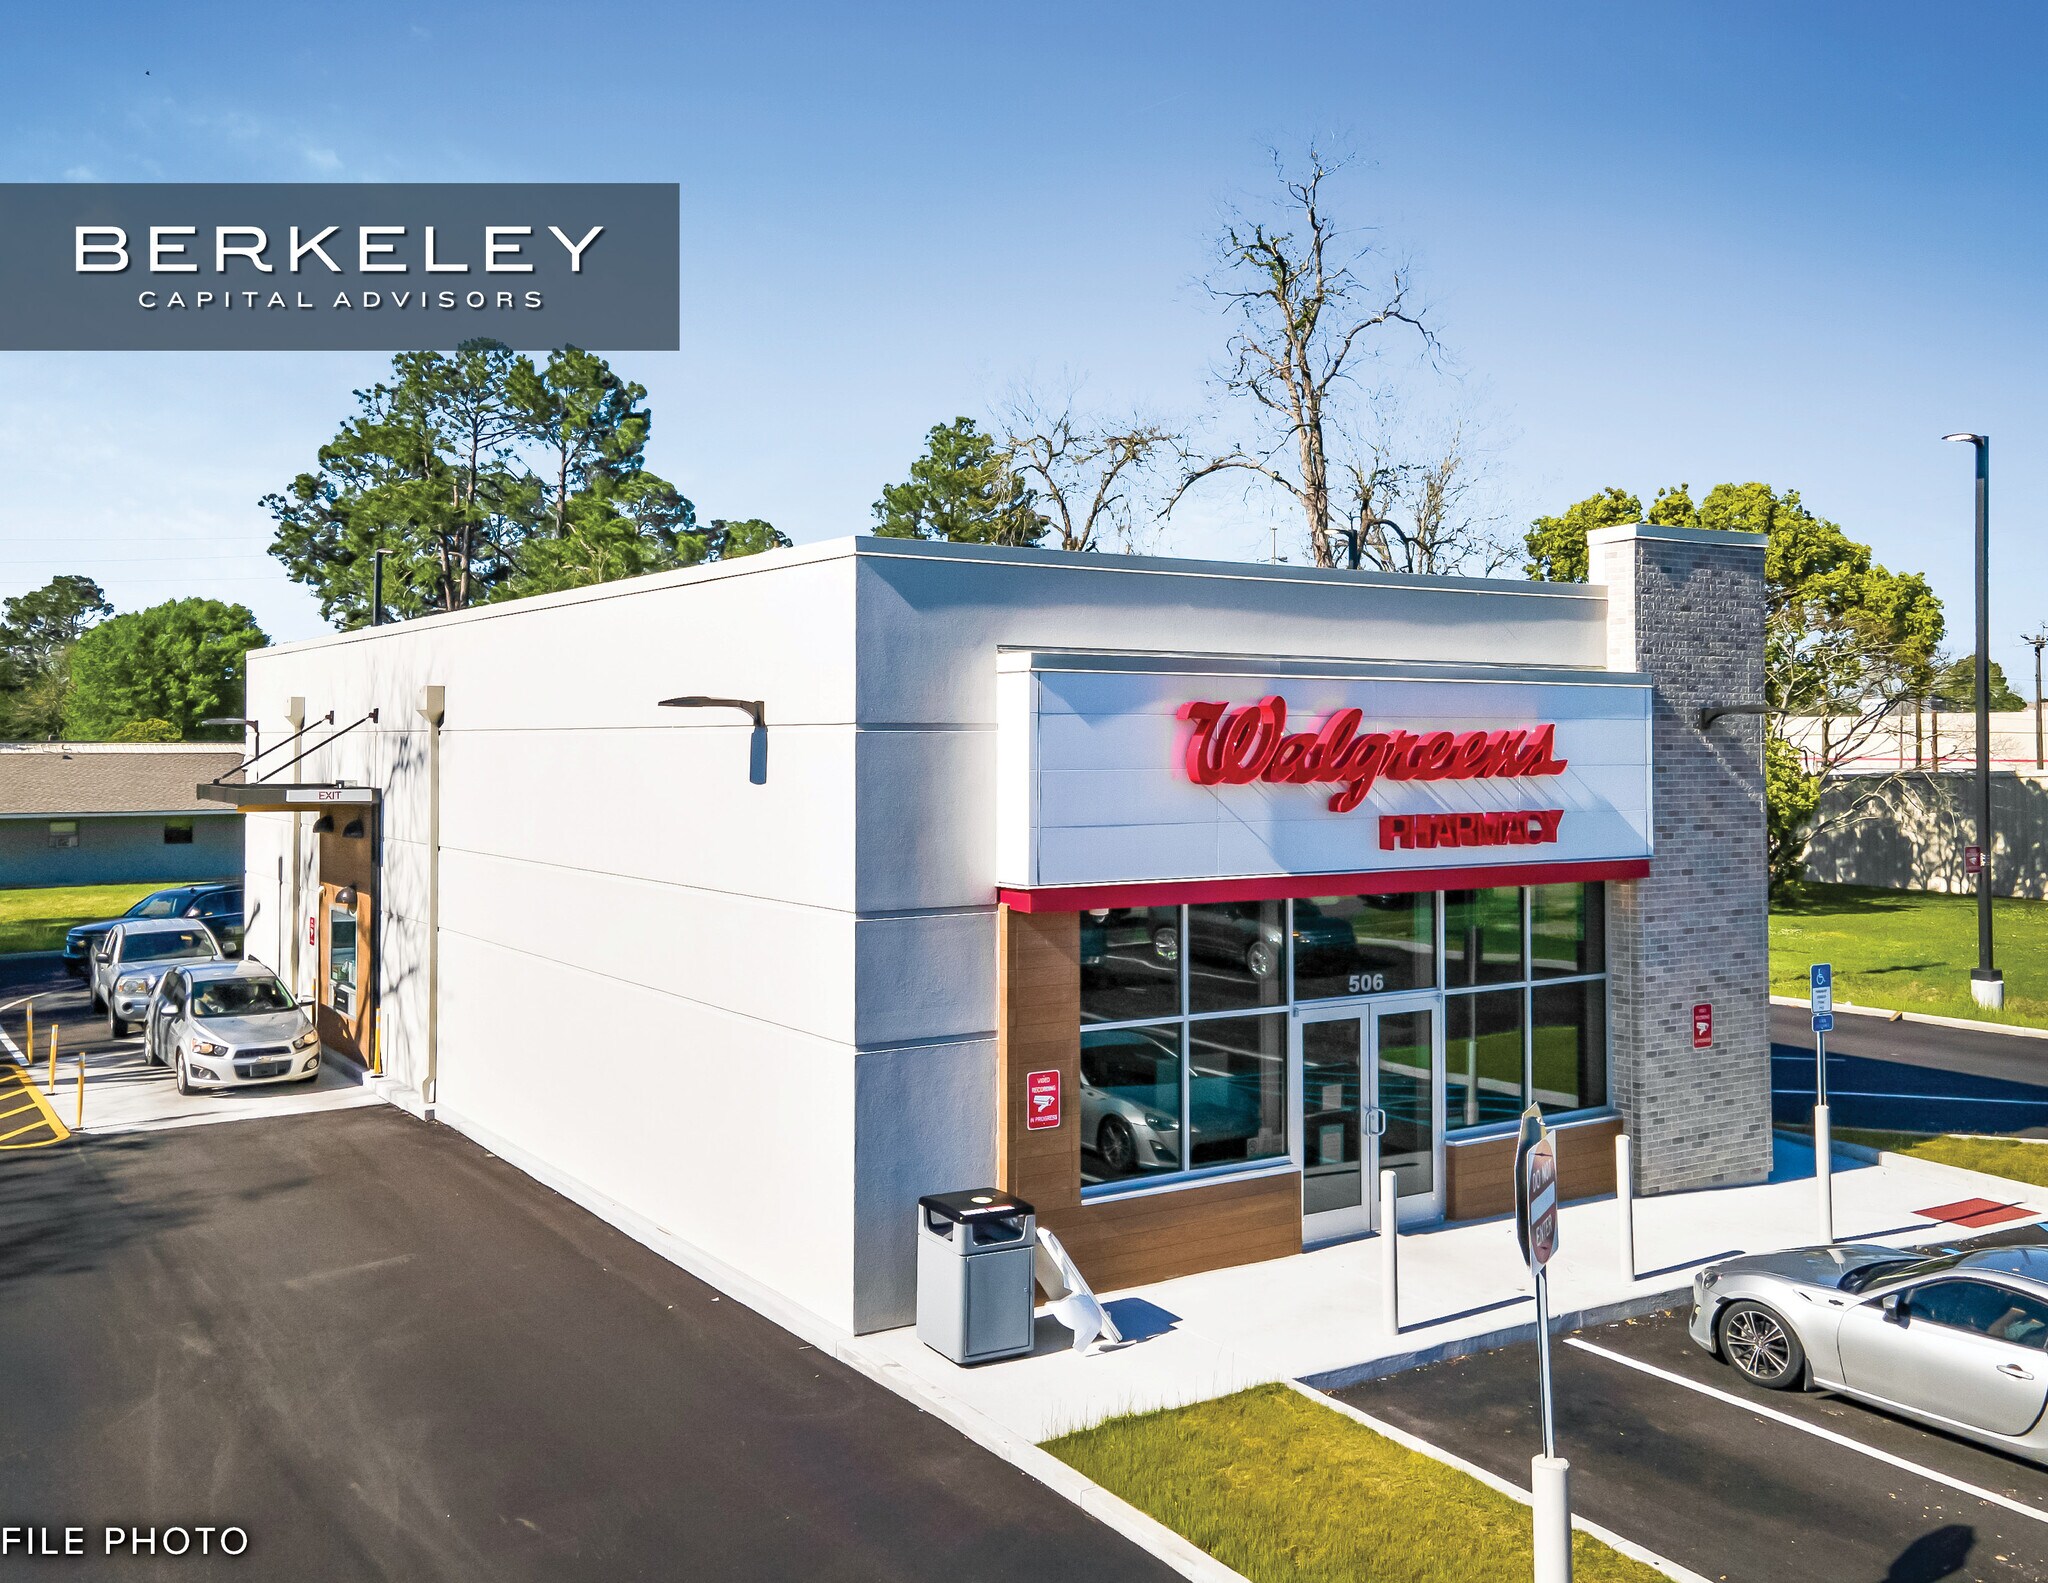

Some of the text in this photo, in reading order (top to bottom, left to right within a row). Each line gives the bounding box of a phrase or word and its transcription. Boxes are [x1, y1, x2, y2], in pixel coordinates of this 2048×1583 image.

[1177, 695, 1568, 813] Walgreens
[318, 791, 342, 800] EXIT
[1379, 809, 1565, 850] PHARMACY
[1348, 973, 1384, 993] 506
[1532, 1169, 1541, 1193] DO
[1536, 1213, 1553, 1247] ENTER
